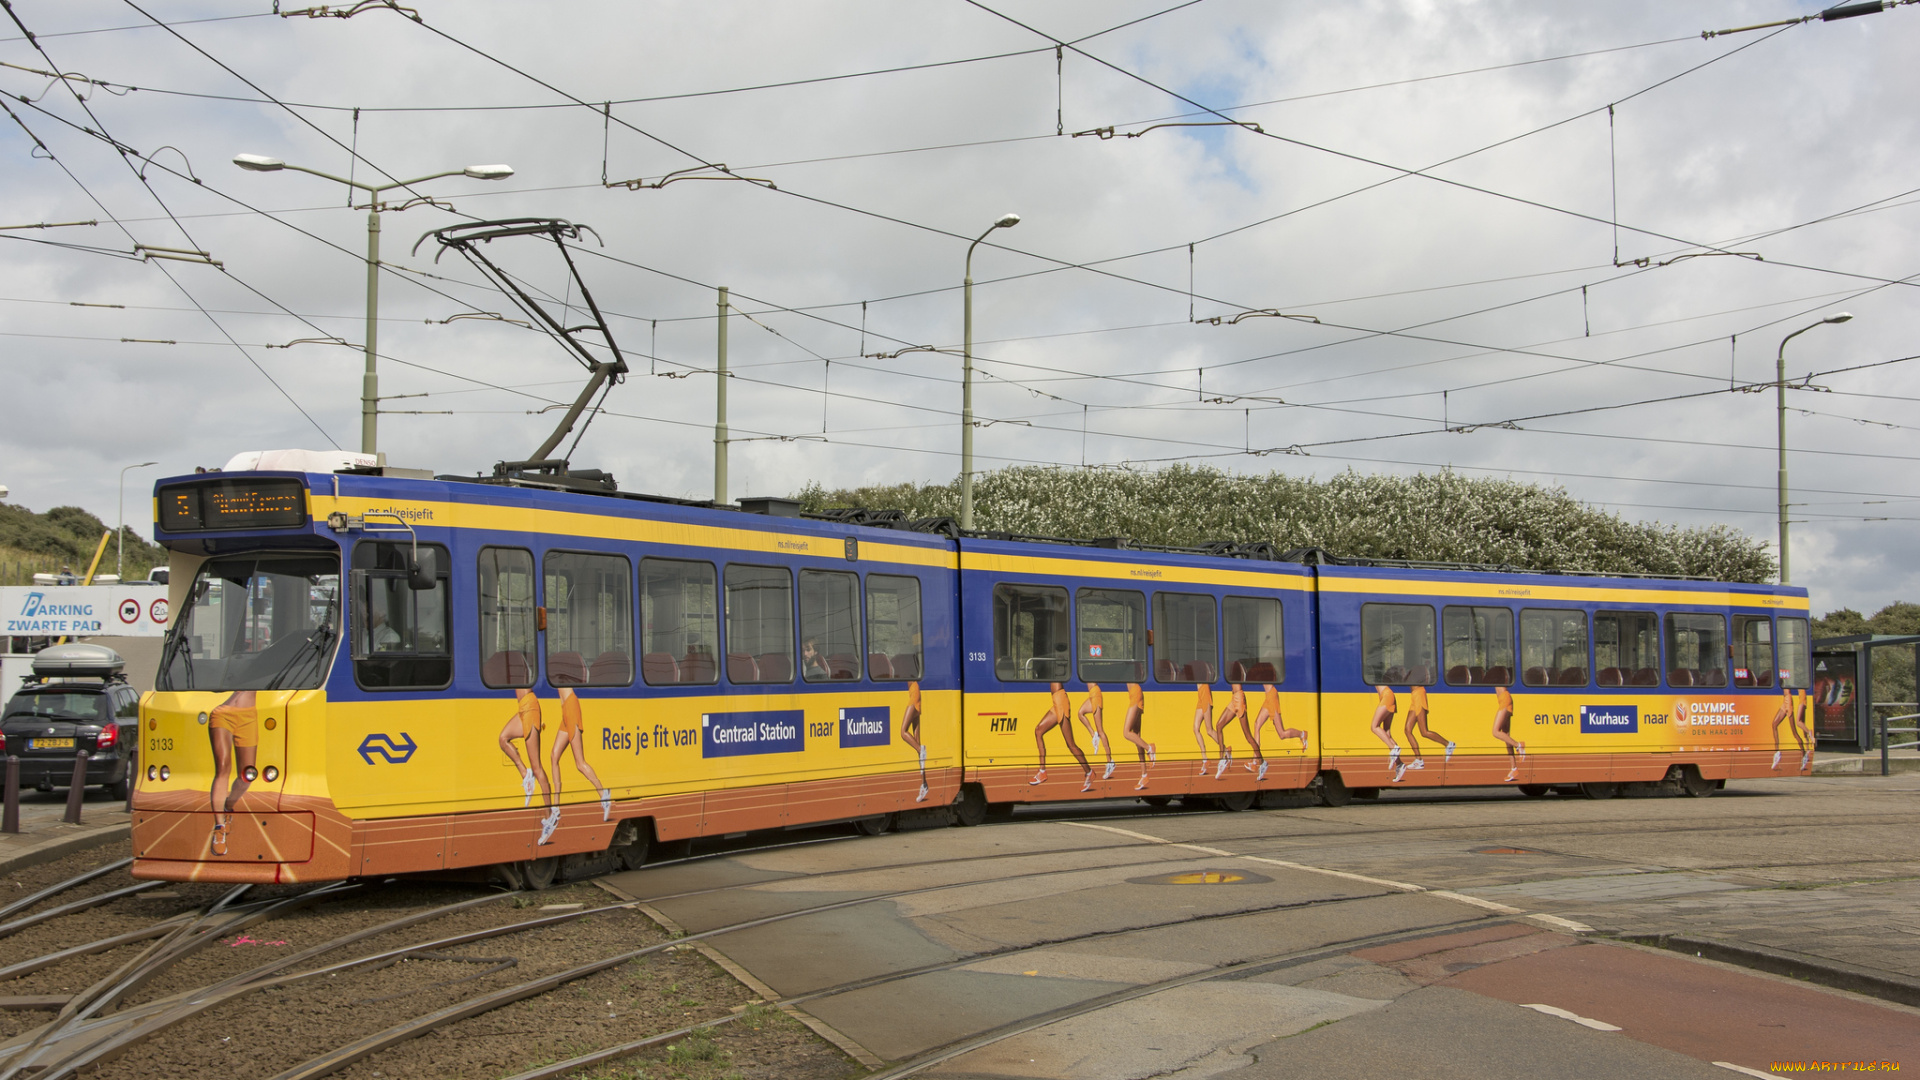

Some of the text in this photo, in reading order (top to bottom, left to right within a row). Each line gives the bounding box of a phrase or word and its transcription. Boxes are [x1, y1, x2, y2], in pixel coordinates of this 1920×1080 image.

[355, 458, 376, 467] DENSO
[21, 592, 93, 617] PARKING
[7, 620, 101, 631] ZWARTE PAD
[968, 652, 987, 662] 3133
[1690, 702, 1736, 713] OLYMPIC
[1534, 711, 1669, 725] en van Kurhaus naar
[1690, 714, 1750, 726] EXPERIENCE
[990, 717, 1018, 732] HTM
[602, 717, 883, 756] Reis je fit van Centraal Station naar Kurhaus
[150, 738, 173, 751] 3133
